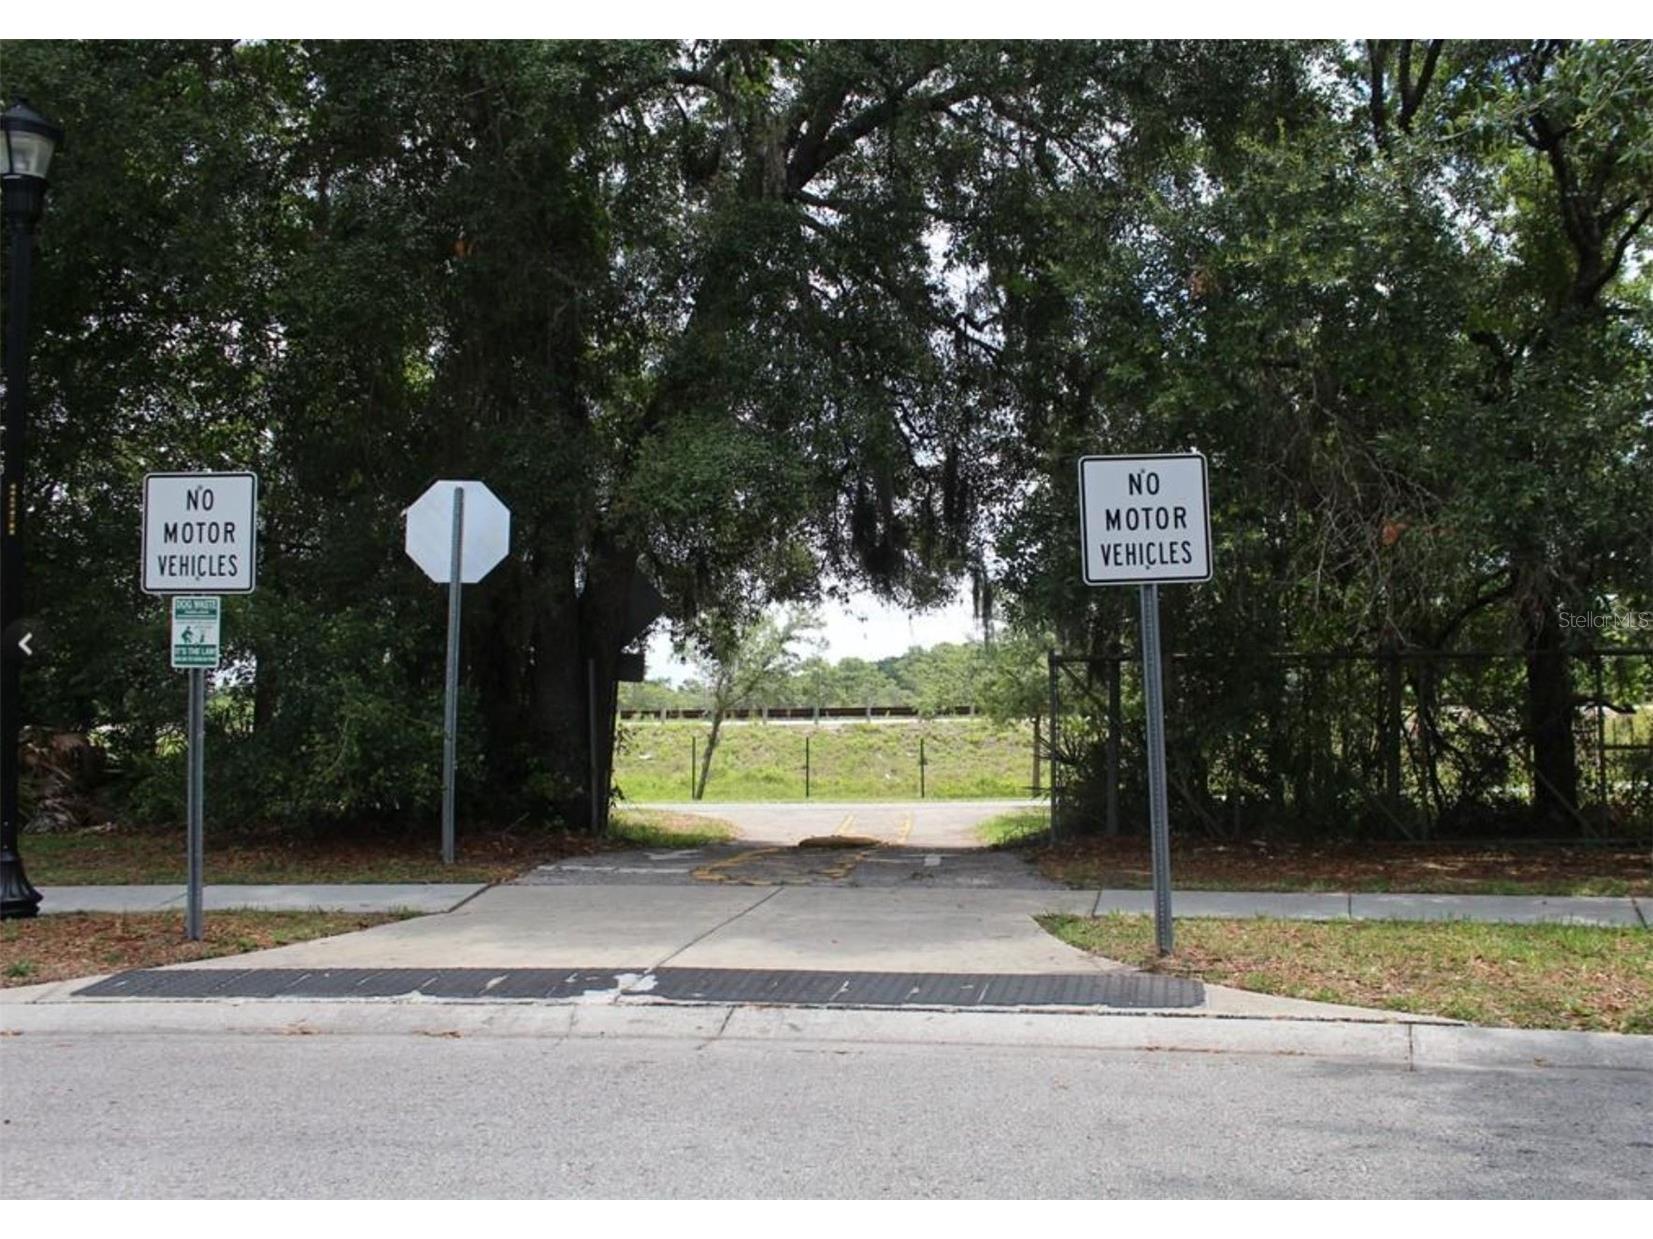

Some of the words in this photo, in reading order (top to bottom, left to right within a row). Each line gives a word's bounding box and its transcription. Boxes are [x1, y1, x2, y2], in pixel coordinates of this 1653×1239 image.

[1128, 472, 1160, 495] NO
[187, 488, 214, 511] NO
[1105, 506, 1187, 531] MOTOR
[164, 521, 235, 544] MOTOR
[158, 554, 238, 577] VEHICLES
[1100, 541, 1192, 567] VEHICLES
[176, 599, 192, 610] DOG
